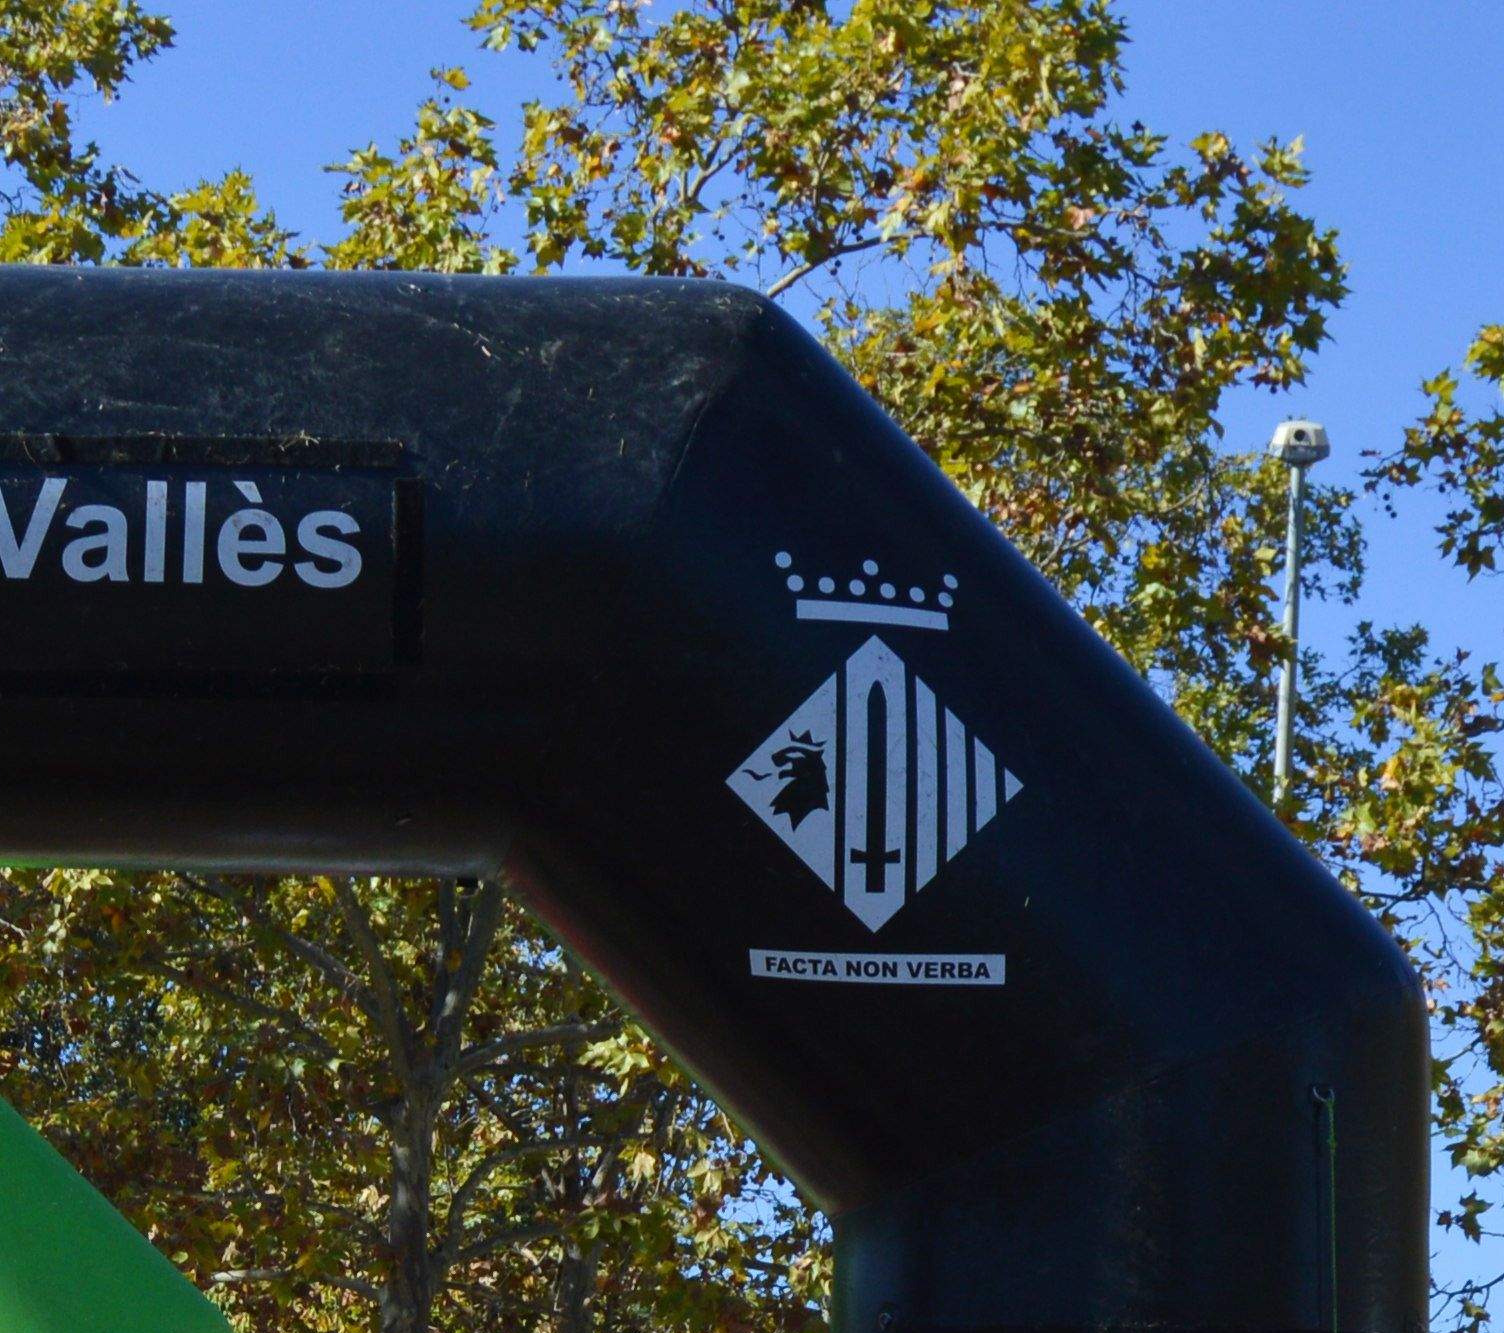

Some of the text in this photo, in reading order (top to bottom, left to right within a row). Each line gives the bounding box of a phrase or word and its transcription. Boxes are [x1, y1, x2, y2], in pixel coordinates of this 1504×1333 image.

[765, 956, 990, 979] FACTA NON VERBA
